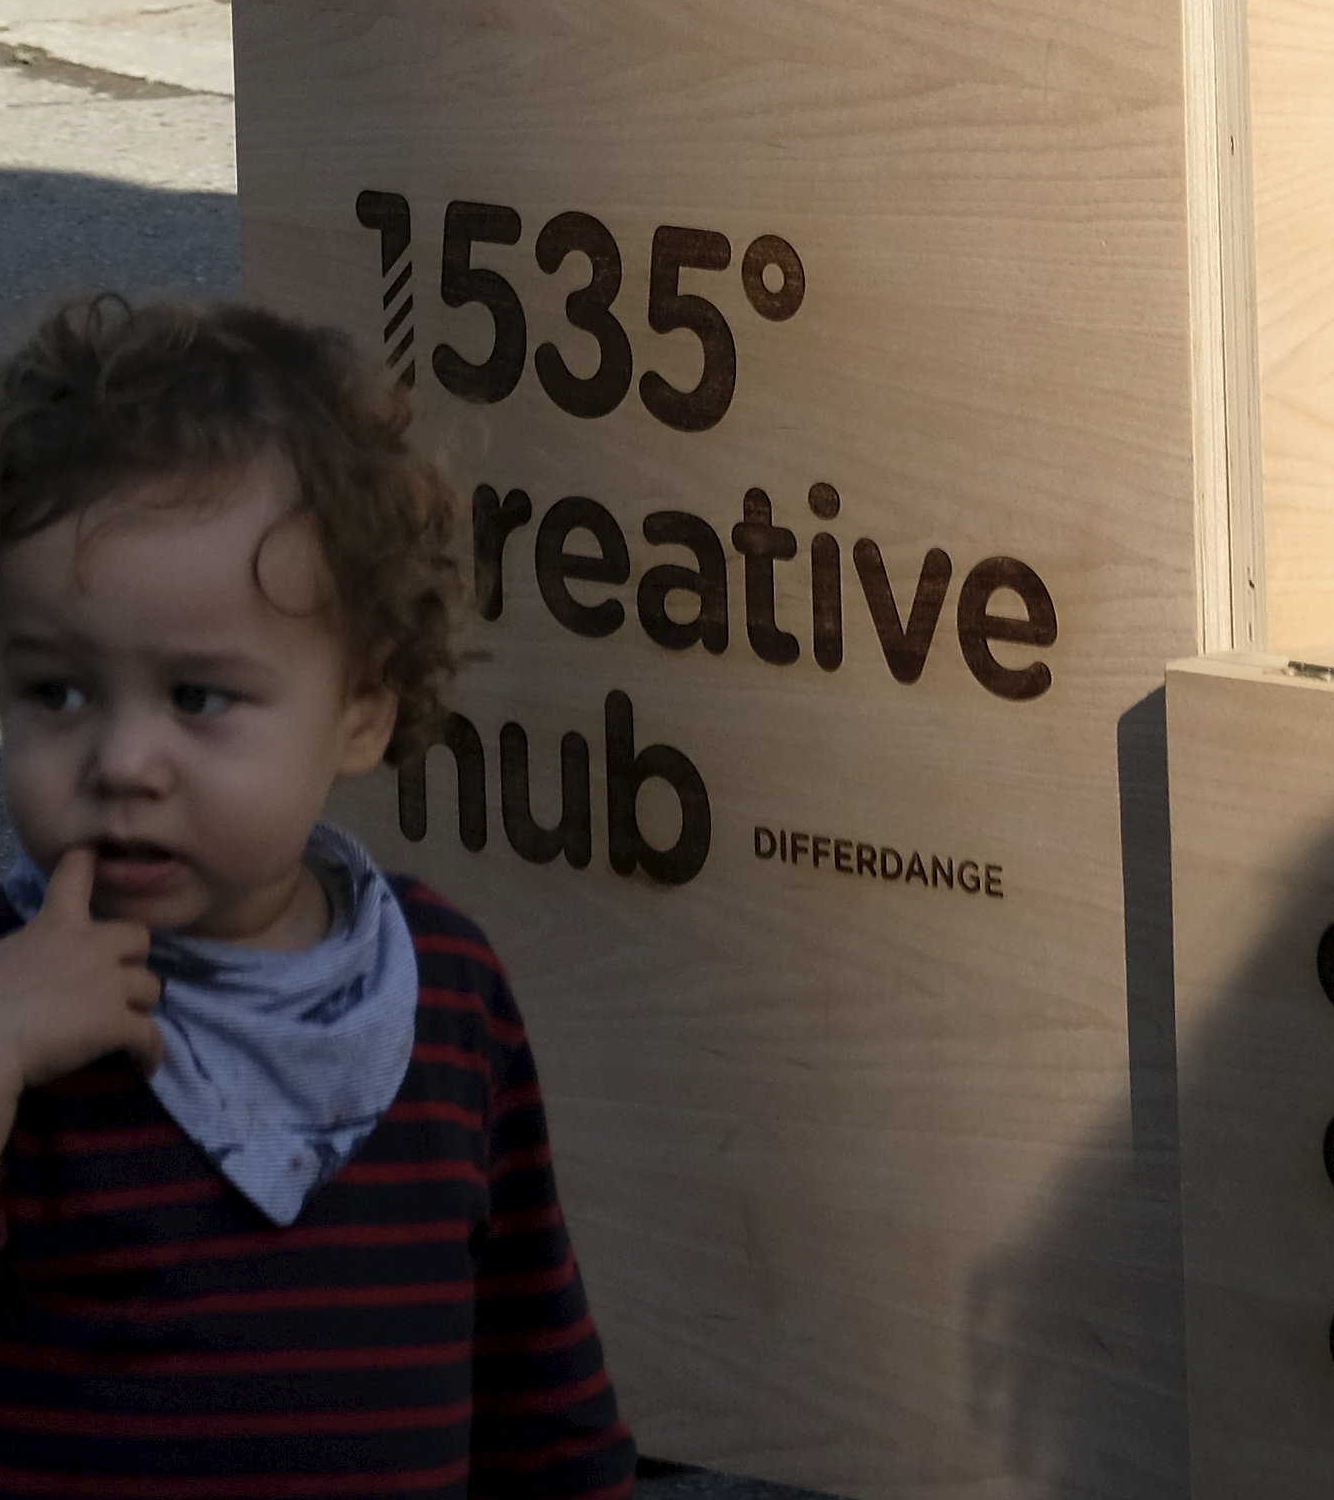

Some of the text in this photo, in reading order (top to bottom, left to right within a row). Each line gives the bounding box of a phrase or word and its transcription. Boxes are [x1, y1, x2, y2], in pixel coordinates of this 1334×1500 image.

[355, 189, 806, 433] 1535°
[471, 482, 1059, 703] reative
[754, 826, 1005, 900] DIFFERDANGE
